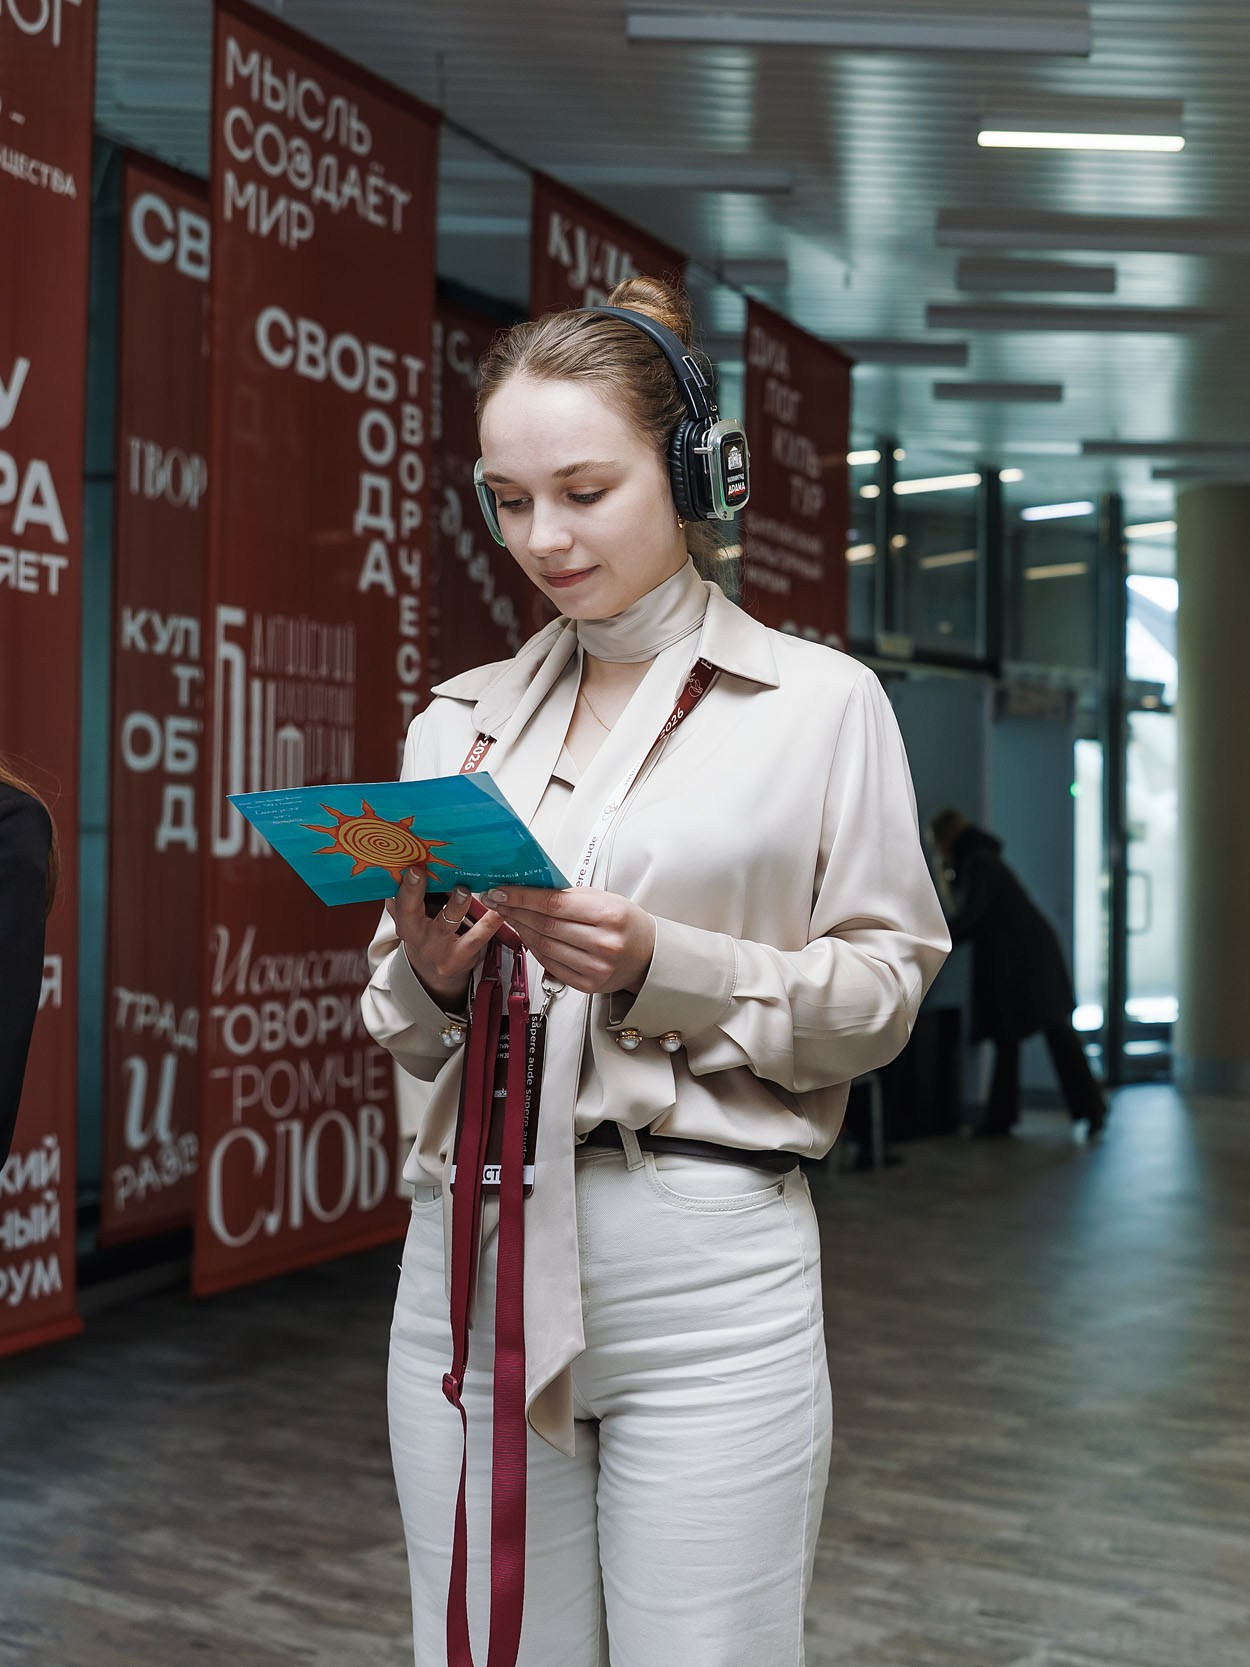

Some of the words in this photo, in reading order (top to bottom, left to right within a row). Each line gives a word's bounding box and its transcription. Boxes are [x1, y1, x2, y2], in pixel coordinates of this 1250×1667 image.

[0, 0, 82, 46] ОГ
[225, 36, 372, 156] МЫСЛЬ
[0, 145, 77, 200] ЩЕСТВА
[223, 105, 410, 233] СОЗДАЁТ
[223, 169, 314, 250] МИР
[172, 662, 204, 709] Т
[659, 707, 685, 739] 2026
[464, 737, 489, 771] 2026
[583, 835, 599, 866] aude
[529, 1015, 539, 1053] sapere
[525, 1056, 536, 1086] aude
[123, 1052, 178, 1151] И
